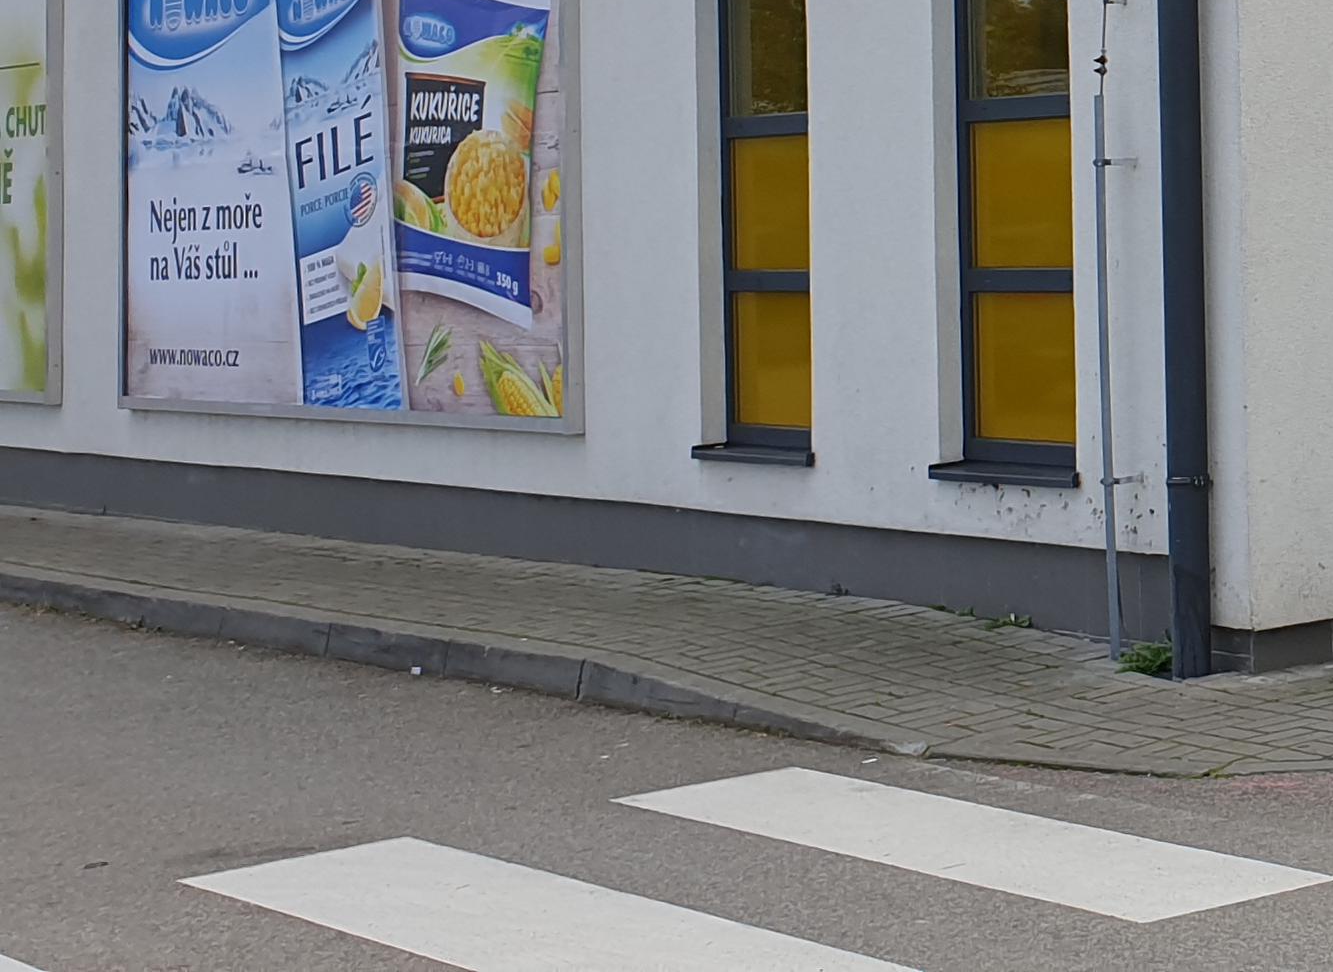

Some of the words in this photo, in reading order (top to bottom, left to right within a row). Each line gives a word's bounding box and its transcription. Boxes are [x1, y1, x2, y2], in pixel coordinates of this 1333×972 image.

[410, 85, 481, 123] KUKUŘICE
[295, 94, 375, 190] FILÉ
[150, 197, 197, 245] Nejen
[201, 206, 211, 230] z
[216, 193, 262, 230] moře
[150, 256, 169, 281] na
[173, 244, 201, 280] Váš
[205, 240, 238, 280] stůl
[496, 271, 512, 290] 350
[512, 281, 519, 297] g
[149, 348, 240, 368] www.nowaco.cz
